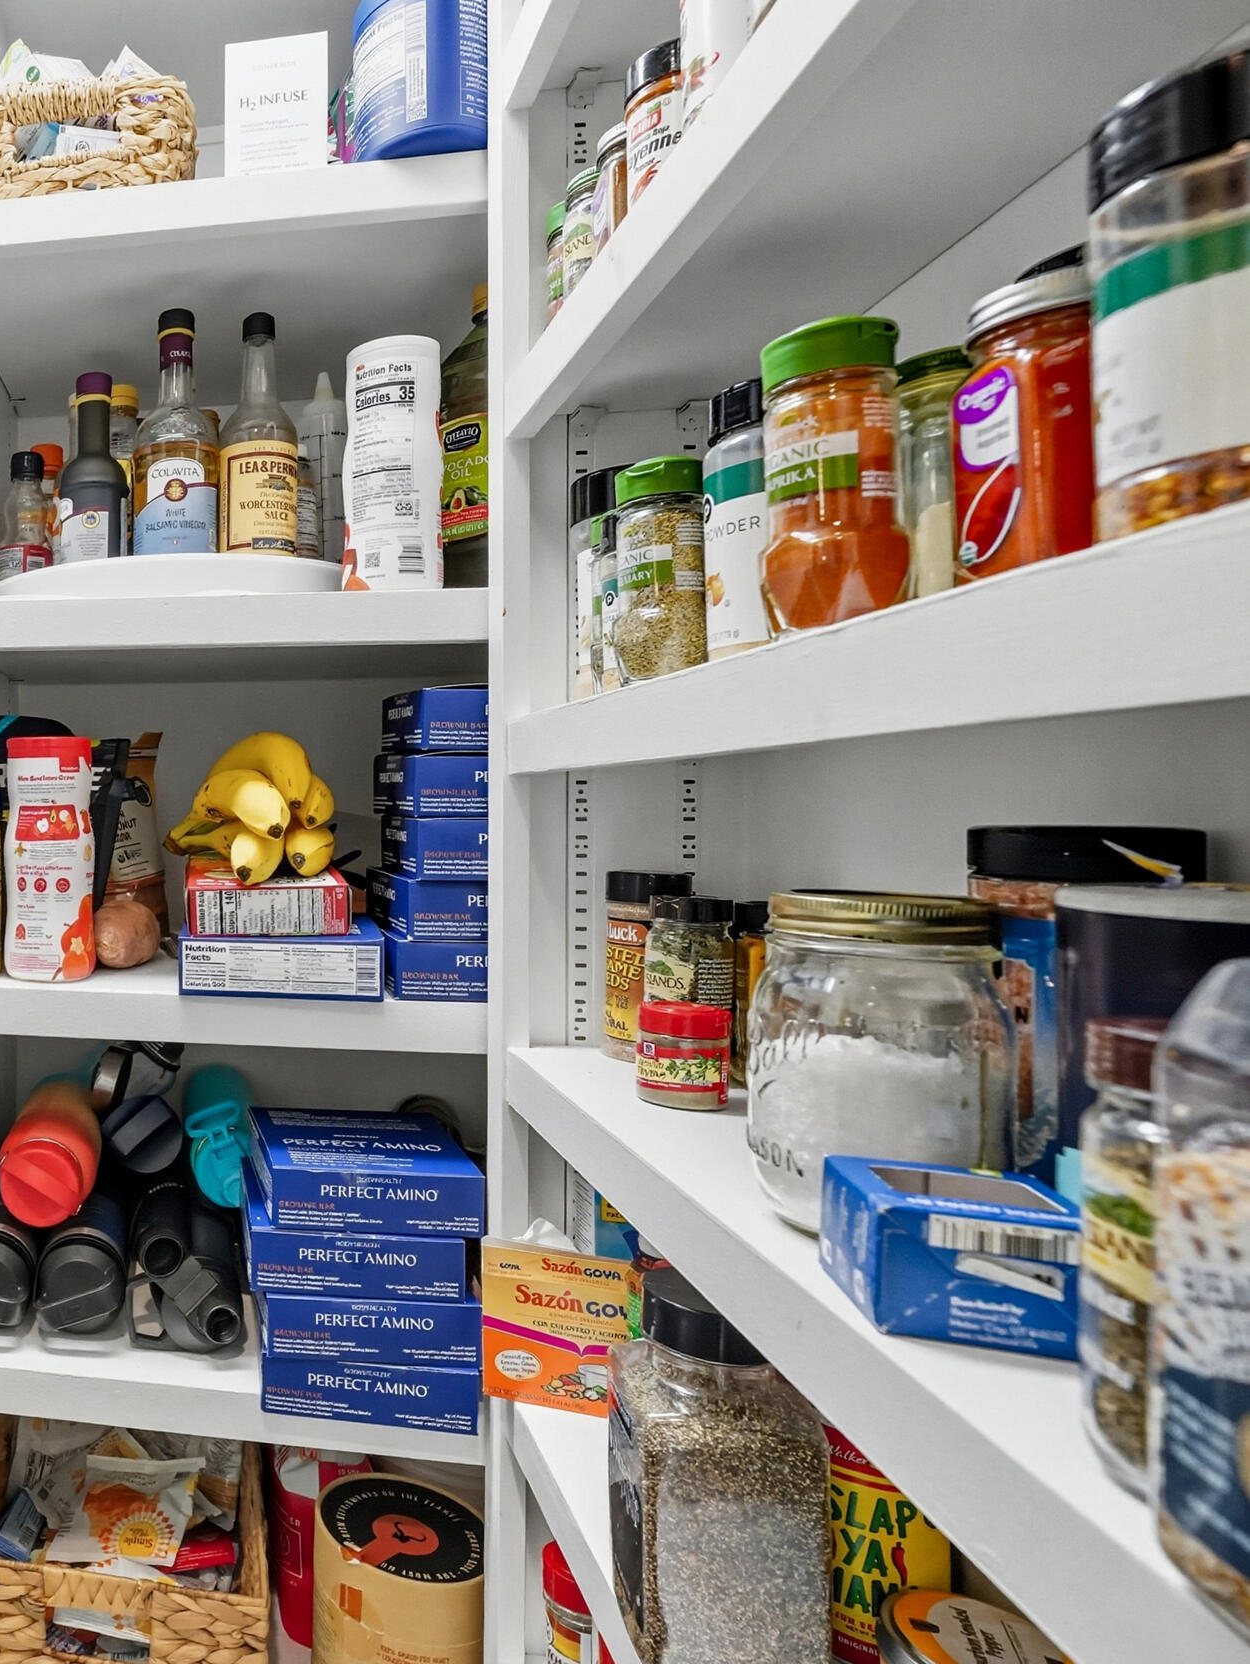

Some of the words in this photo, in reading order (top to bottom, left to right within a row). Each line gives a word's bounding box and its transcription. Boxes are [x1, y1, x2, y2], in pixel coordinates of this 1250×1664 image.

[259, 90, 308, 105] INFUSE
[356, 365, 386, 380] Nutrition
[388, 363, 412, 373] Facts
[356, 392, 391, 409] Calories
[399, 386, 415, 400] 35
[445, 426, 479, 444] OTTAVIO
[151, 465, 201, 479] COLAVITA
[451, 467, 471, 480] OIL
[185, 945, 227, 953] Nutrition
[185, 954, 211, 962] Facts
[283, 1138, 368, 1149] PERFECT
[373, 1140, 442, 1152] AMINO
[320, 1185, 385, 1200] PERFECT
[386, 1189, 439, 1201] AMINO
[299, 1248, 363, 1263] PERFECT
[364, 1253, 417, 1267] AMINO
[541, 1258, 582, 1276] Sazón
[583, 1267, 623, 1282] GOYA
[515, 1284, 584, 1314] Sazón
[315, 1313, 379, 1328] PERFECT
[380, 1317, 434, 1331] AMINO
[532, 1319, 548, 1327] CON
[307, 1373, 372, 1391] PERFECT
[373, 1381, 429, 1398] AMINO
[831, 1484, 918, 1539] SLAP
[123, 1535, 153, 1548] Simple
[840, 1527, 889, 1578] YA
[833, 1565, 910, 1618] AM
